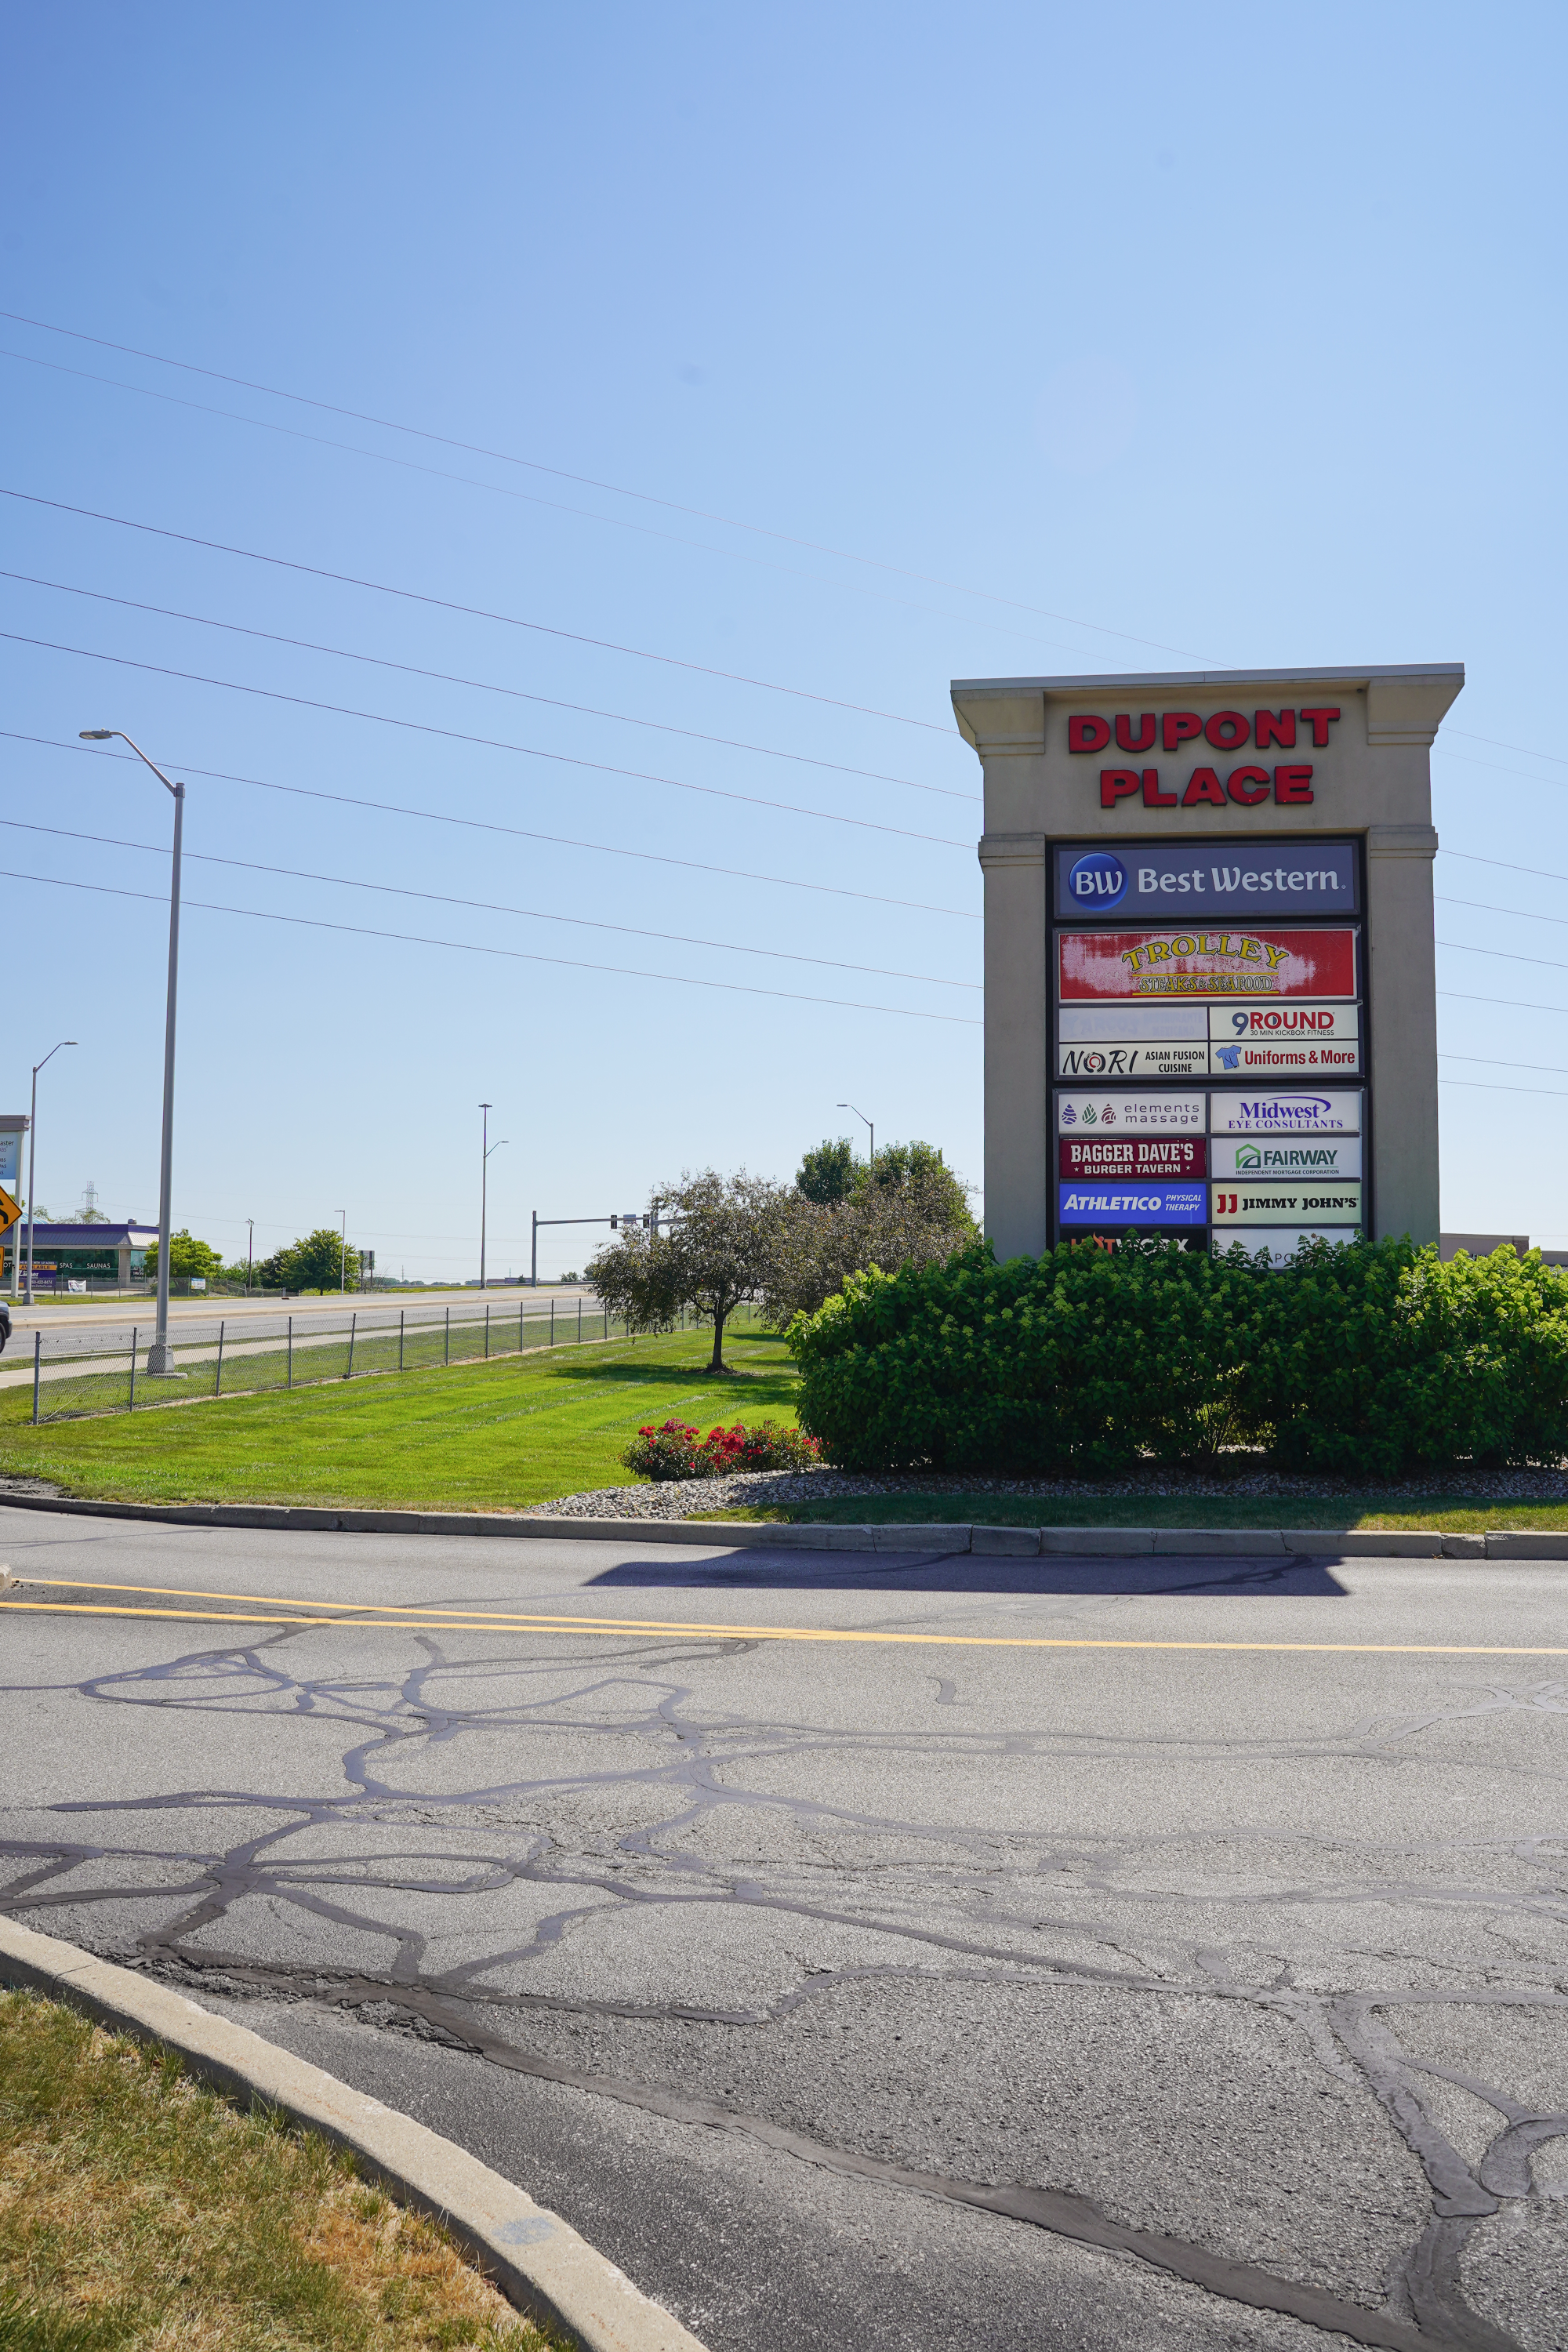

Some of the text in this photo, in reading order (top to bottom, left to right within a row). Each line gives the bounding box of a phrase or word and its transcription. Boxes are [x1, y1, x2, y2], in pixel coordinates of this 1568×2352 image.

[1069, 708, 1341, 753] DUPONT
[1100, 765, 1314, 808] PLACE
[1076, 870, 1123, 895] BW
[1138, 867, 1339, 893] Best Western
[1121, 935, 1289, 972] TROLLEY
[1139, 977, 1197, 992] STEAKS
[1207, 976, 1272, 991] SEAFOOD
[1232, 1012, 1334, 1036] 9ROUND
[1062, 1050, 1138, 1074] NORI
[1145, 1051, 1205, 1061] ASIAN FUSION
[1244, 1050, 1355, 1065] Uniforms & More
[1158, 1063, 1192, 1073] CUISINE
[1124, 1103, 1200, 1112] elements
[1240, 1102, 1319, 1119] Midwest
[1125, 1115, 1199, 1124] massage
[1228, 1120, 1343, 1129] EYE CONSULTANTS
[1070, 1142, 1194, 1163] BAGGER DAVE'S
[1264, 1150, 1338, 1166] FAIRWAY
[1084, 1163, 1181, 1174] BURGER TAVERN
[1063, 1194, 1162, 1210] ATHLETICO
[1217, 1194, 1238, 1214] JJ
[1243, 1197, 1357, 1210] JIMMY JOHN'S
